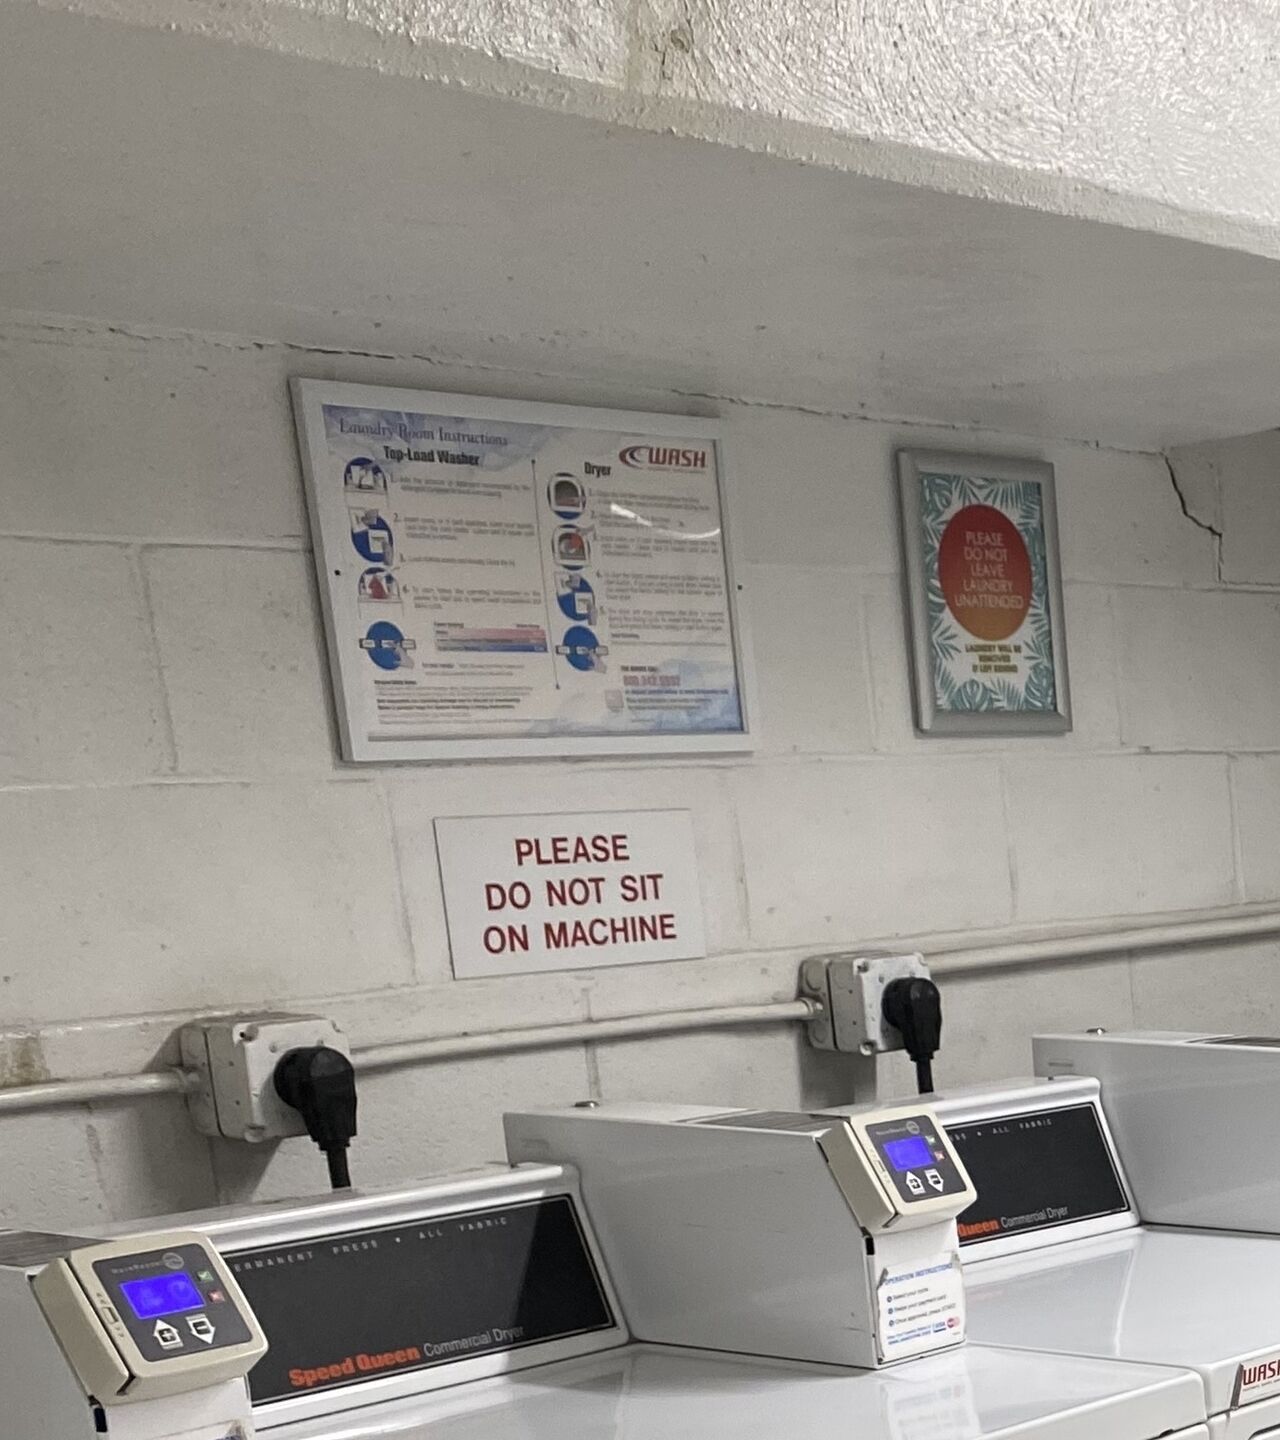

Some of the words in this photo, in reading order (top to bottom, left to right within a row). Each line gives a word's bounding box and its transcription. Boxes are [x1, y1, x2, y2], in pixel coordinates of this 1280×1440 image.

[399, 423, 434, 441] Room
[439, 427, 508, 446] Instructions
[383, 446, 435, 462] Top-Load
[437, 450, 480, 465] Washer
[649, 447, 706, 468] WASH
[584, 461, 612, 478] Dryer
[966, 531, 1004, 547] PLEASE
[964, 546, 983, 560] DO
[985, 548, 1007, 562] NOT
[971, 562, 1005, 578] LEAVE
[963, 578, 1013, 592] LAUNDRY
[515, 834, 630, 866] PLEASE
[485, 881, 531, 911] DO
[546, 877, 606, 907] NOT
[620, 873, 664, 902] SIT
[483, 924, 530, 954] ON
[543, 914, 677, 949] MACHINE
[957, 1219, 1000, 1237] Queen
[1000, 1210, 1047, 1229] Commercial
[1047, 1205, 1069, 1221] Dryer
[234, 1250, 314, 1273] ERMANENT
[332, 1239, 378, 1255] PRESS
[419, 1228, 443, 1240] ALL
[459, 1216, 508, 1233] FABRIC
[289, 1357, 355, 1387] Speed
[356, 1346, 421, 1371] Queen
[423, 1330, 491, 1358] Commercial
[492, 1325, 525, 1346] Dryer
